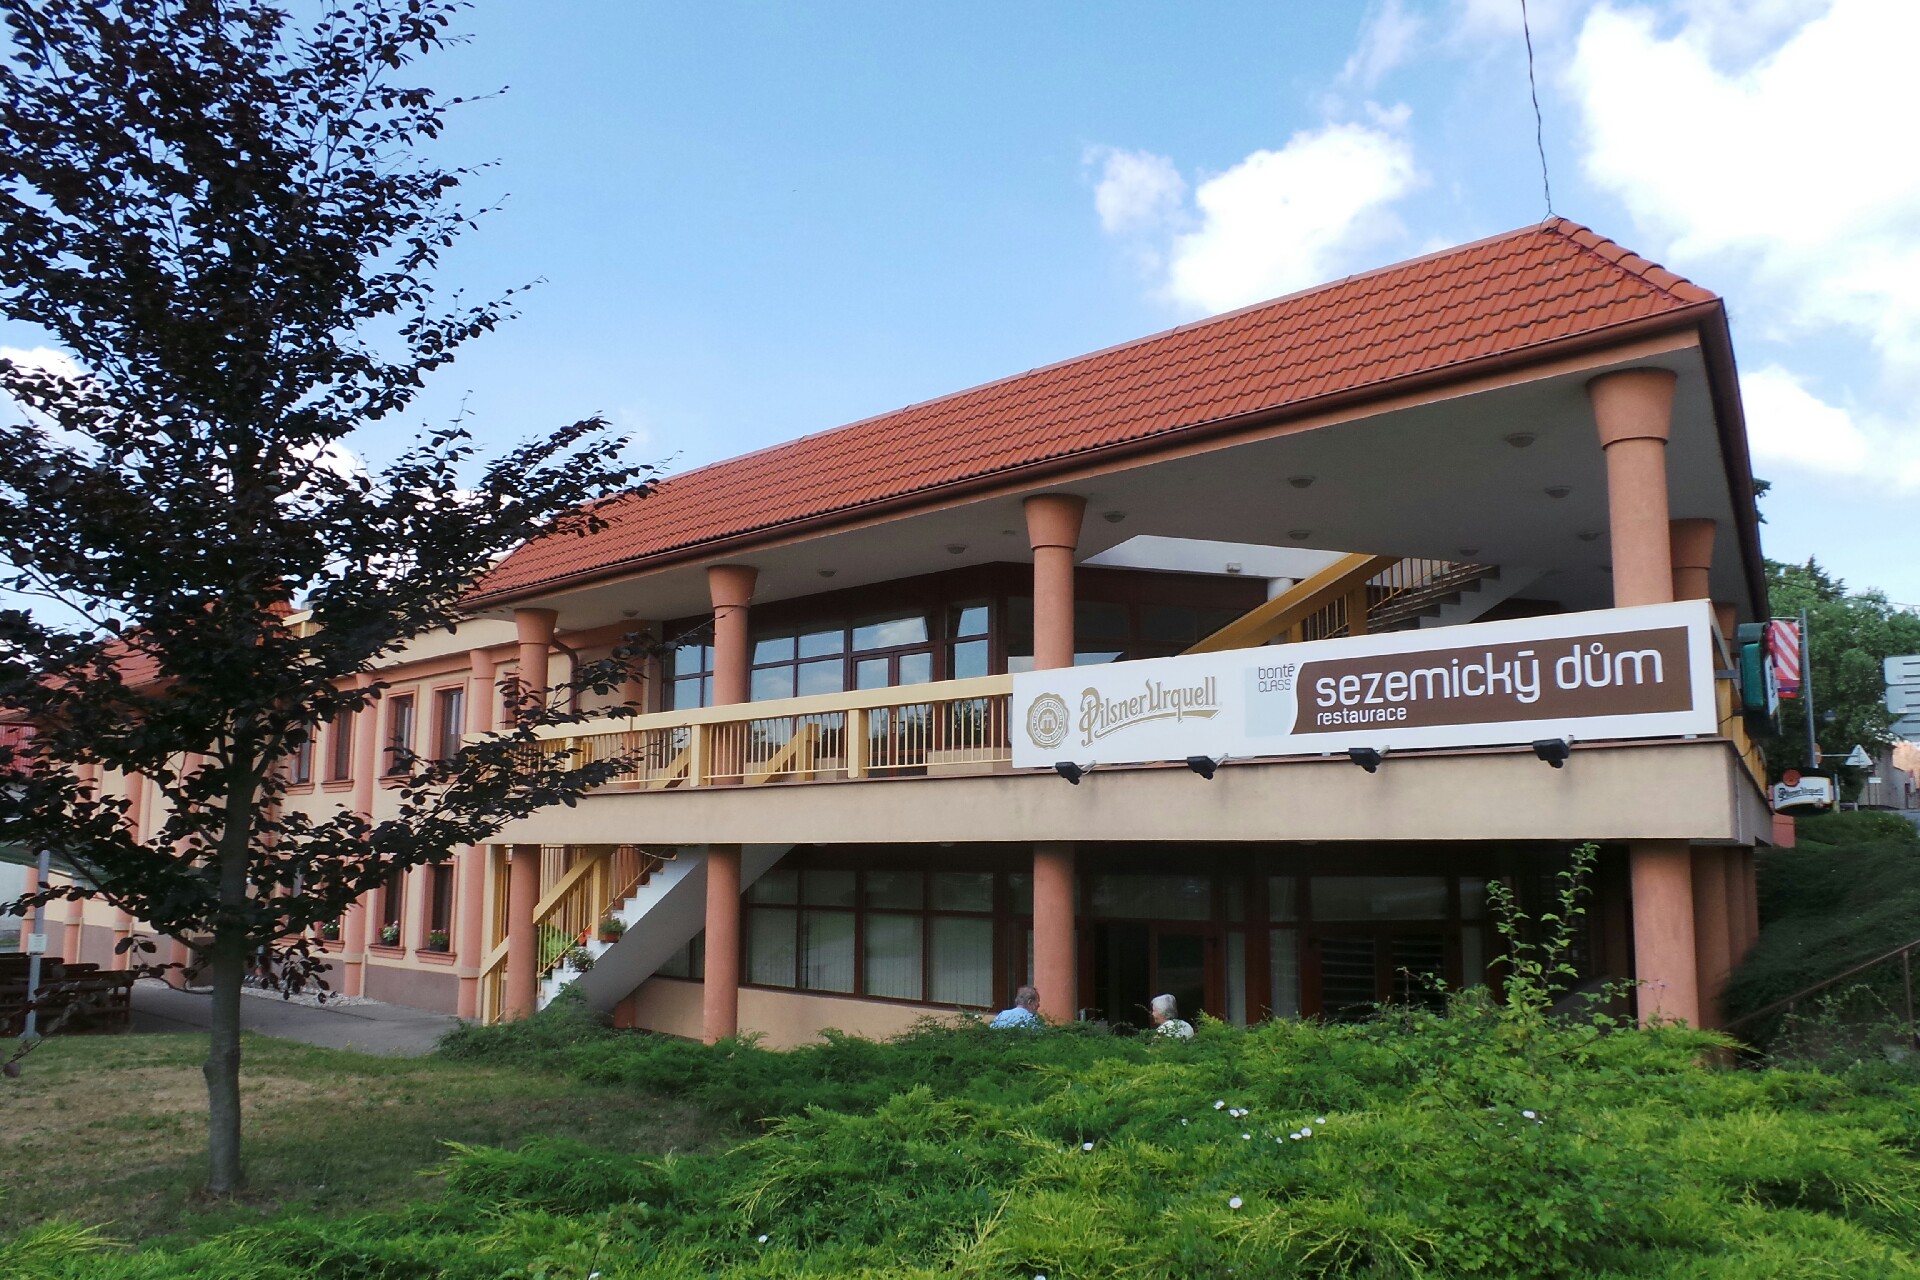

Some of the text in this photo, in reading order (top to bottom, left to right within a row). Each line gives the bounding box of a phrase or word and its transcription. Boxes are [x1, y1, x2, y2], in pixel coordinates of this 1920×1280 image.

[1555, 642, 1664, 690] dům
[1079, 687, 1147, 747] Pilsner
[1145, 676, 1217, 723] Urquell
[1316, 706, 1408, 726] restaurace
